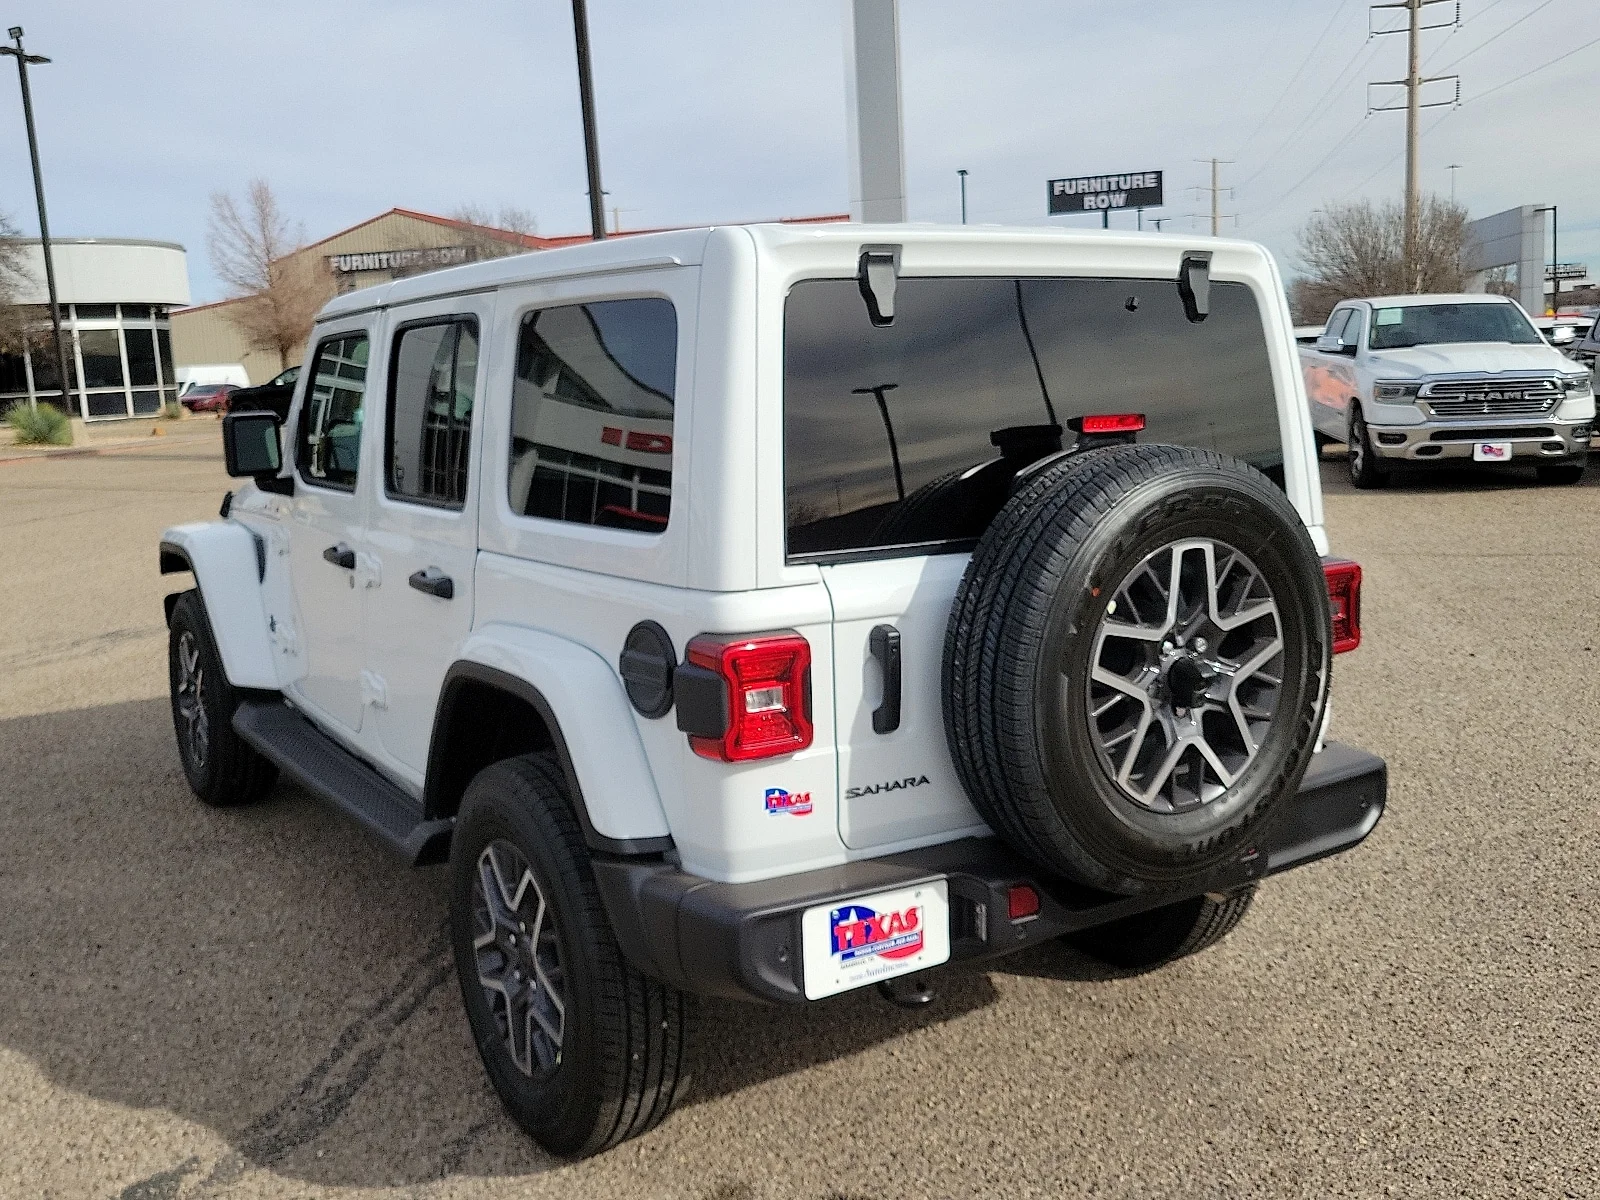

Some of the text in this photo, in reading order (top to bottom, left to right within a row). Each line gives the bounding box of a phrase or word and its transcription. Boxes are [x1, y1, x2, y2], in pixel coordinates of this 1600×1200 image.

[1053, 173, 1159, 196] FURNITURE
[1083, 191, 1128, 210] ROW
[1467, 391, 1522, 401] RAM
[845, 775, 931, 800] SAHARA
[767, 792, 813, 809] TEXAS
[834, 906, 920, 952] TEXAS
